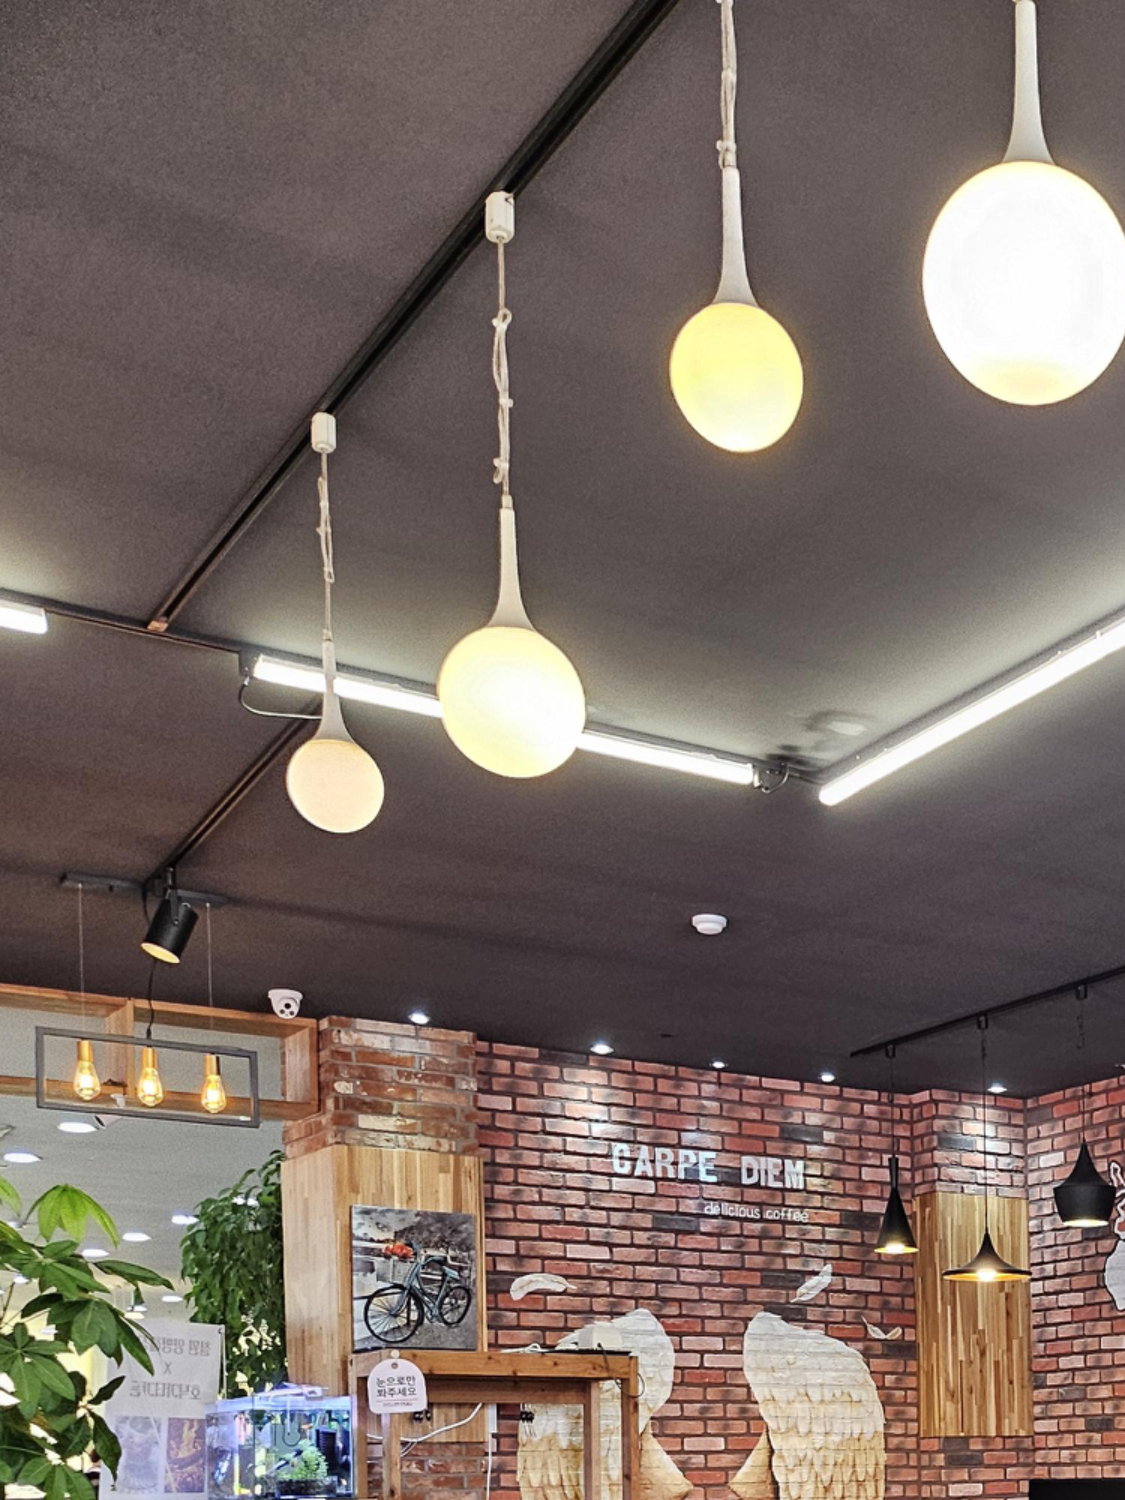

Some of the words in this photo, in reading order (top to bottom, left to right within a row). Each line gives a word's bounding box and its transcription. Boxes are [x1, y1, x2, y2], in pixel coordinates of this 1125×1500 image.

[612, 1143, 719, 1183] CARPE
[741, 1155, 805, 1190] DIEM
[704, 1202, 761, 1219] delicious
[764, 1208, 809, 1223] coffee
[376, 1375, 416, 1388] 눈으로만
[376, 1387, 417, 1398] 봐주세요
